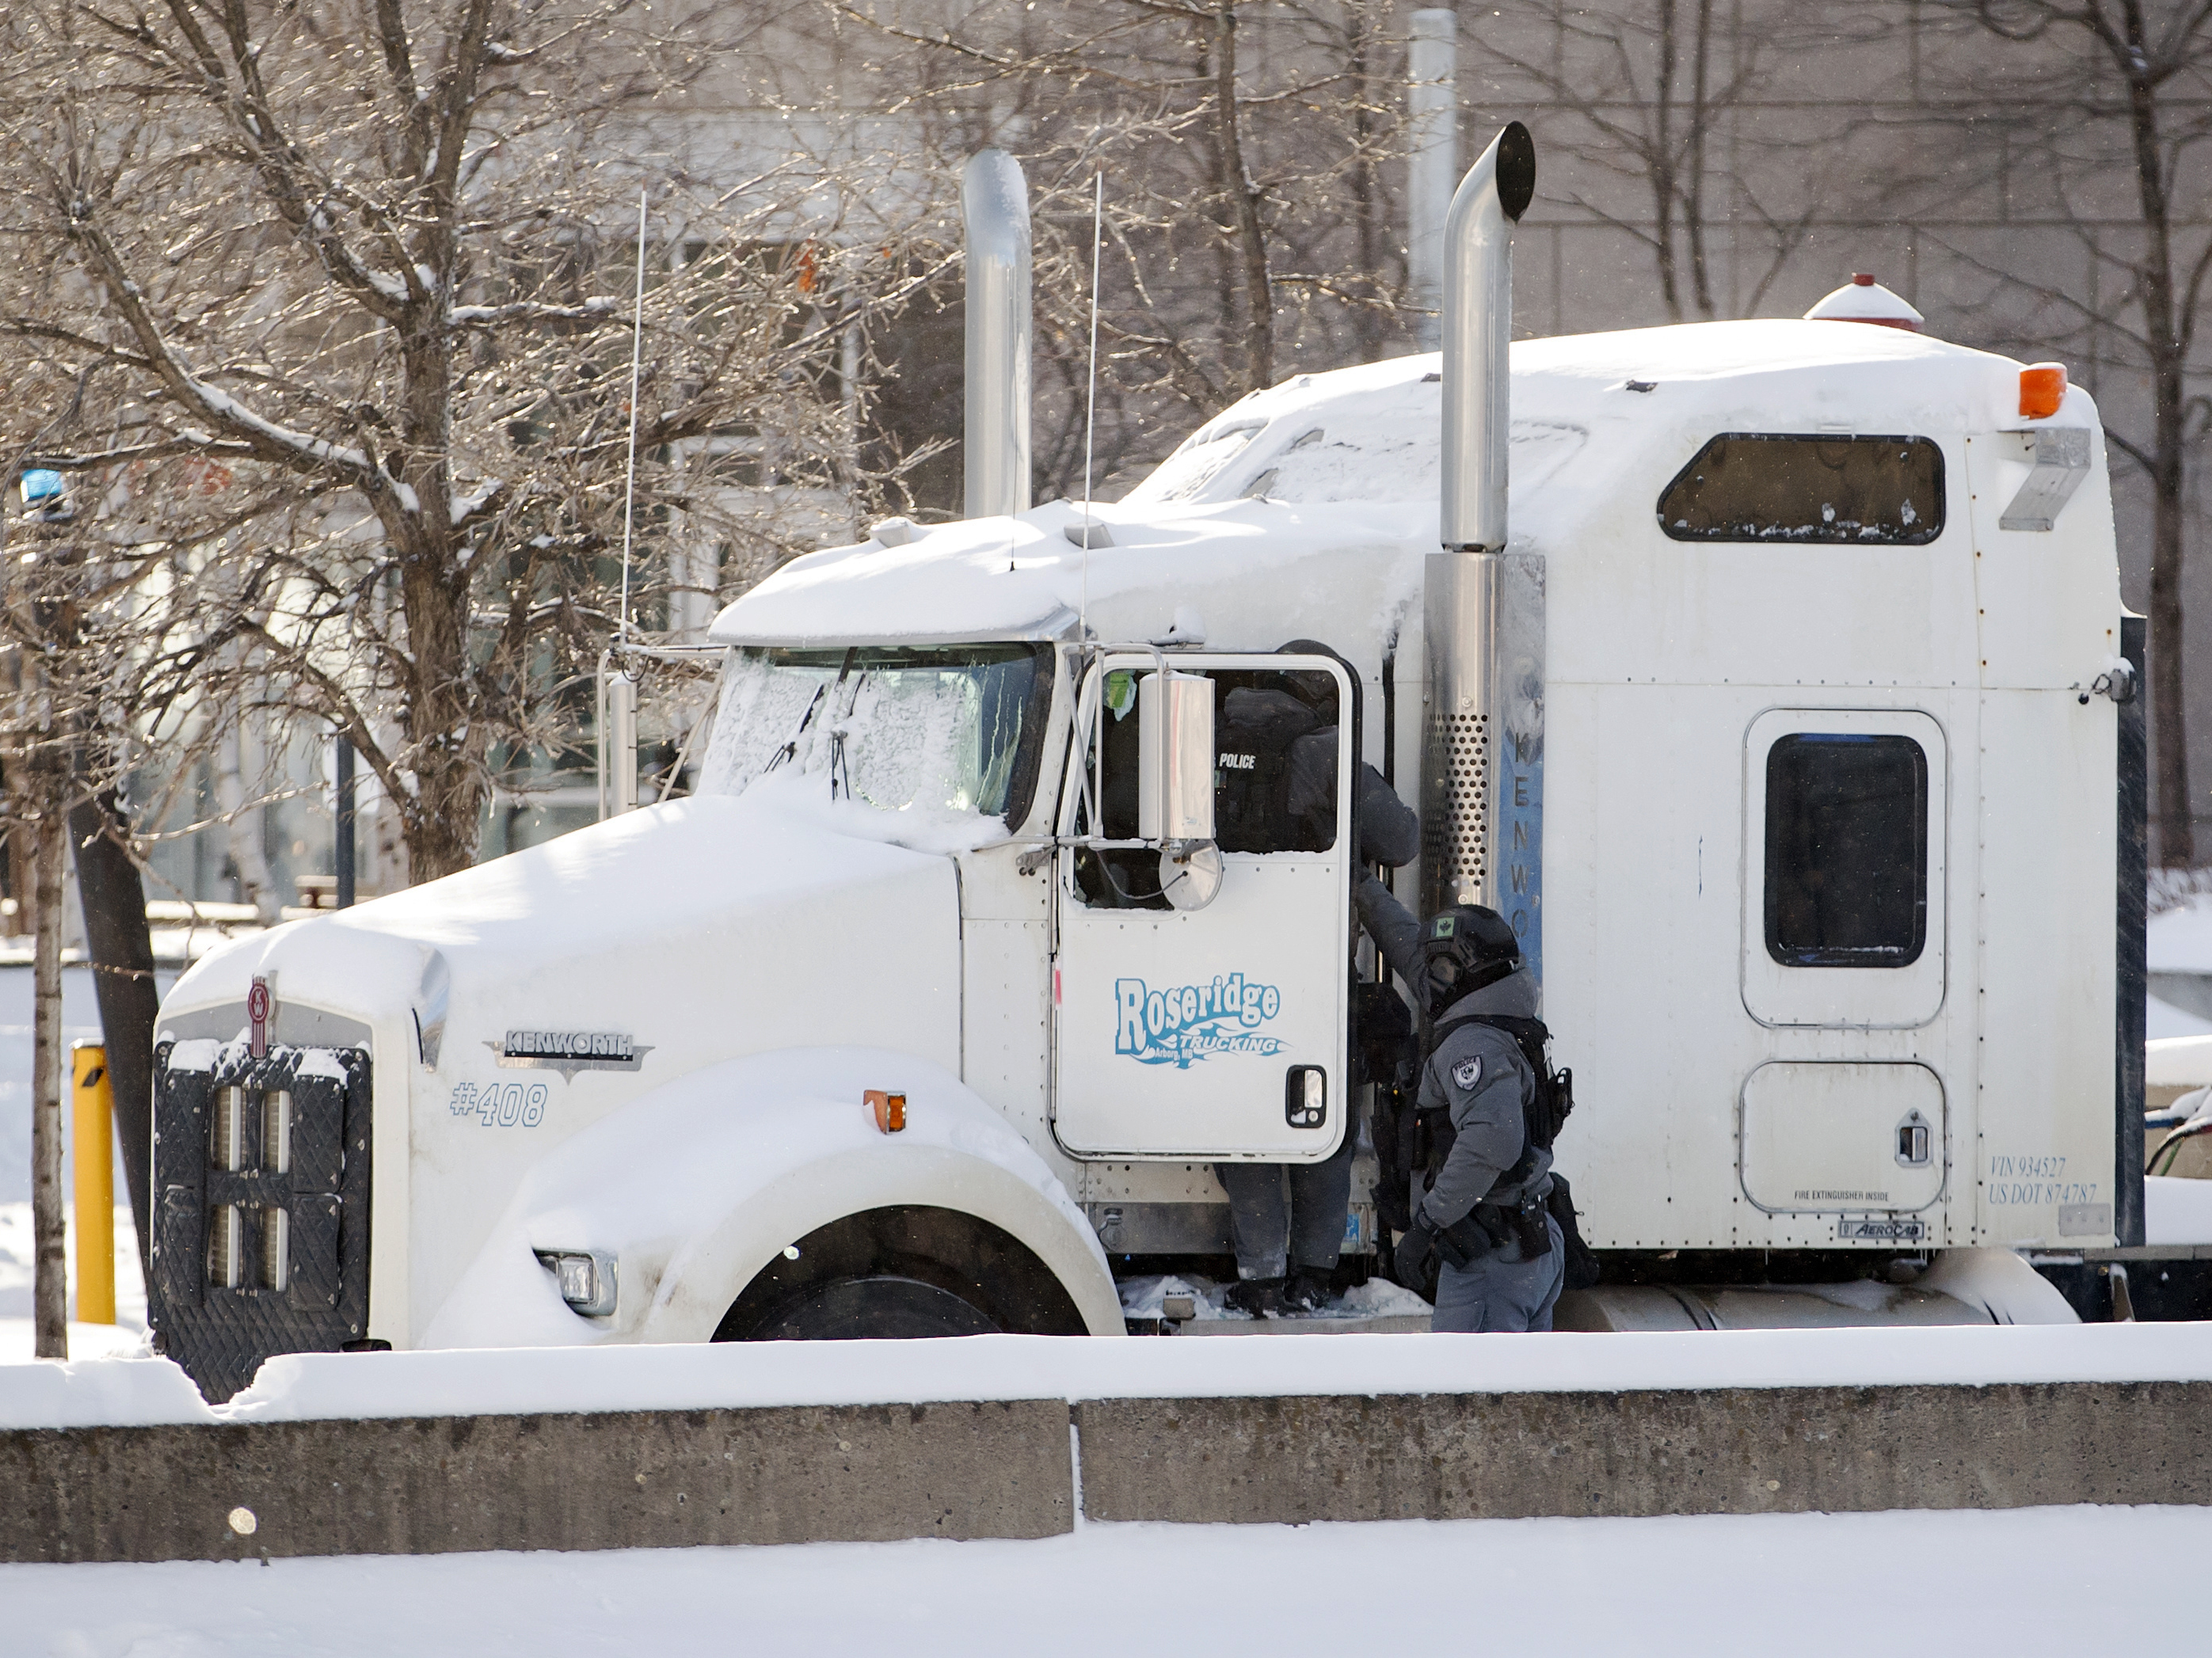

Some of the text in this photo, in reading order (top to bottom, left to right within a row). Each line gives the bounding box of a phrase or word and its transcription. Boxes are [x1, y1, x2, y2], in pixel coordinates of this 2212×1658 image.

[1219, 752, 1256, 770] POLICE
[1115, 972, 1280, 1055] Roseridge
[504, 1030, 634, 1056] KENWORTH
[1155, 1047, 1194, 1062] Arborg, MB
[1180, 1034, 1277, 1052] TRUCKING
[450, 1082, 548, 1128] #408
[1991, 1155, 2066, 1178] VIN 934527
[1794, 1189, 1889, 1202] FIRE EXTINGUISHER INSIDE
[1989, 1182, 2097, 1205] US DOT 874787
